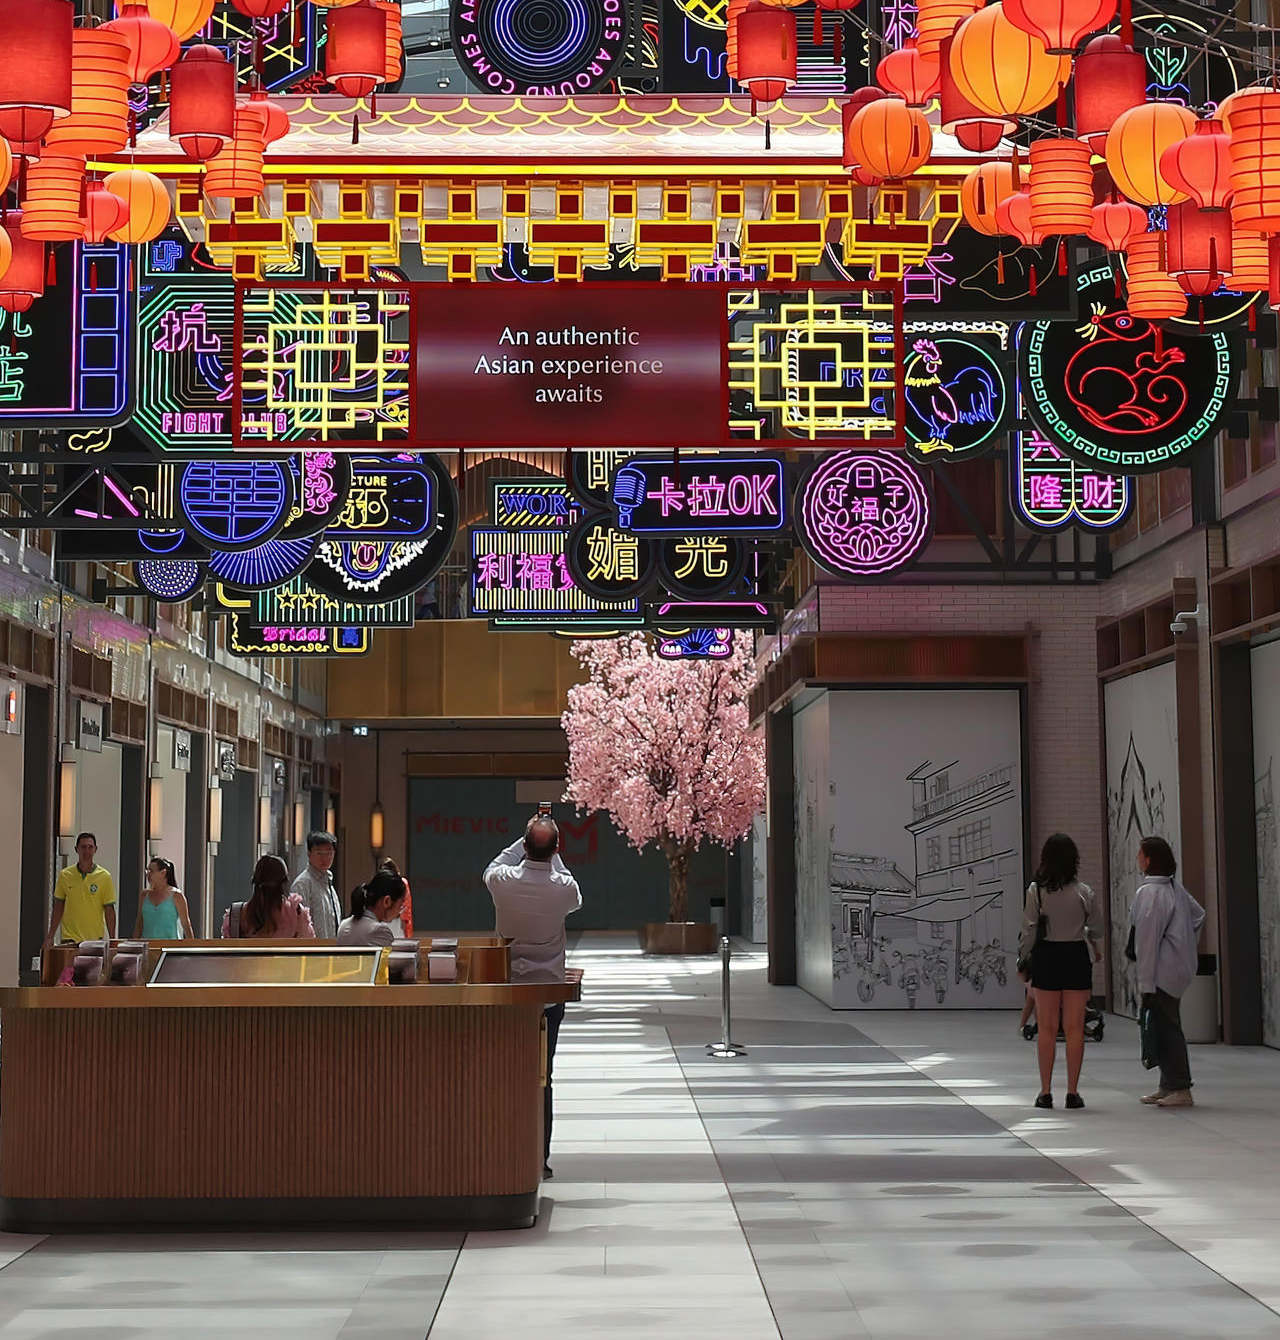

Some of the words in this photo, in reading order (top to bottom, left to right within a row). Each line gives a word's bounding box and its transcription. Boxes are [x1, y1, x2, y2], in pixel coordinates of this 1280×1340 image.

[461, 34, 515, 94] COMES
[152, 302, 221, 353] 抗
[498, 326, 529, 345] An
[535, 325, 640, 345] authentic
[474, 355, 534, 374] Asian
[541, 355, 664, 380] experience
[535, 383, 603, 403] awaits
[162, 412, 224, 433] FIGHT
[350, 475, 388, 487] CTURE
[1082, 474, 1116, 509] 财
[499, 493, 569, 516] WOR
[647, 473, 778, 517] 卡拉OK
[263, 626, 326, 642] Bridal
